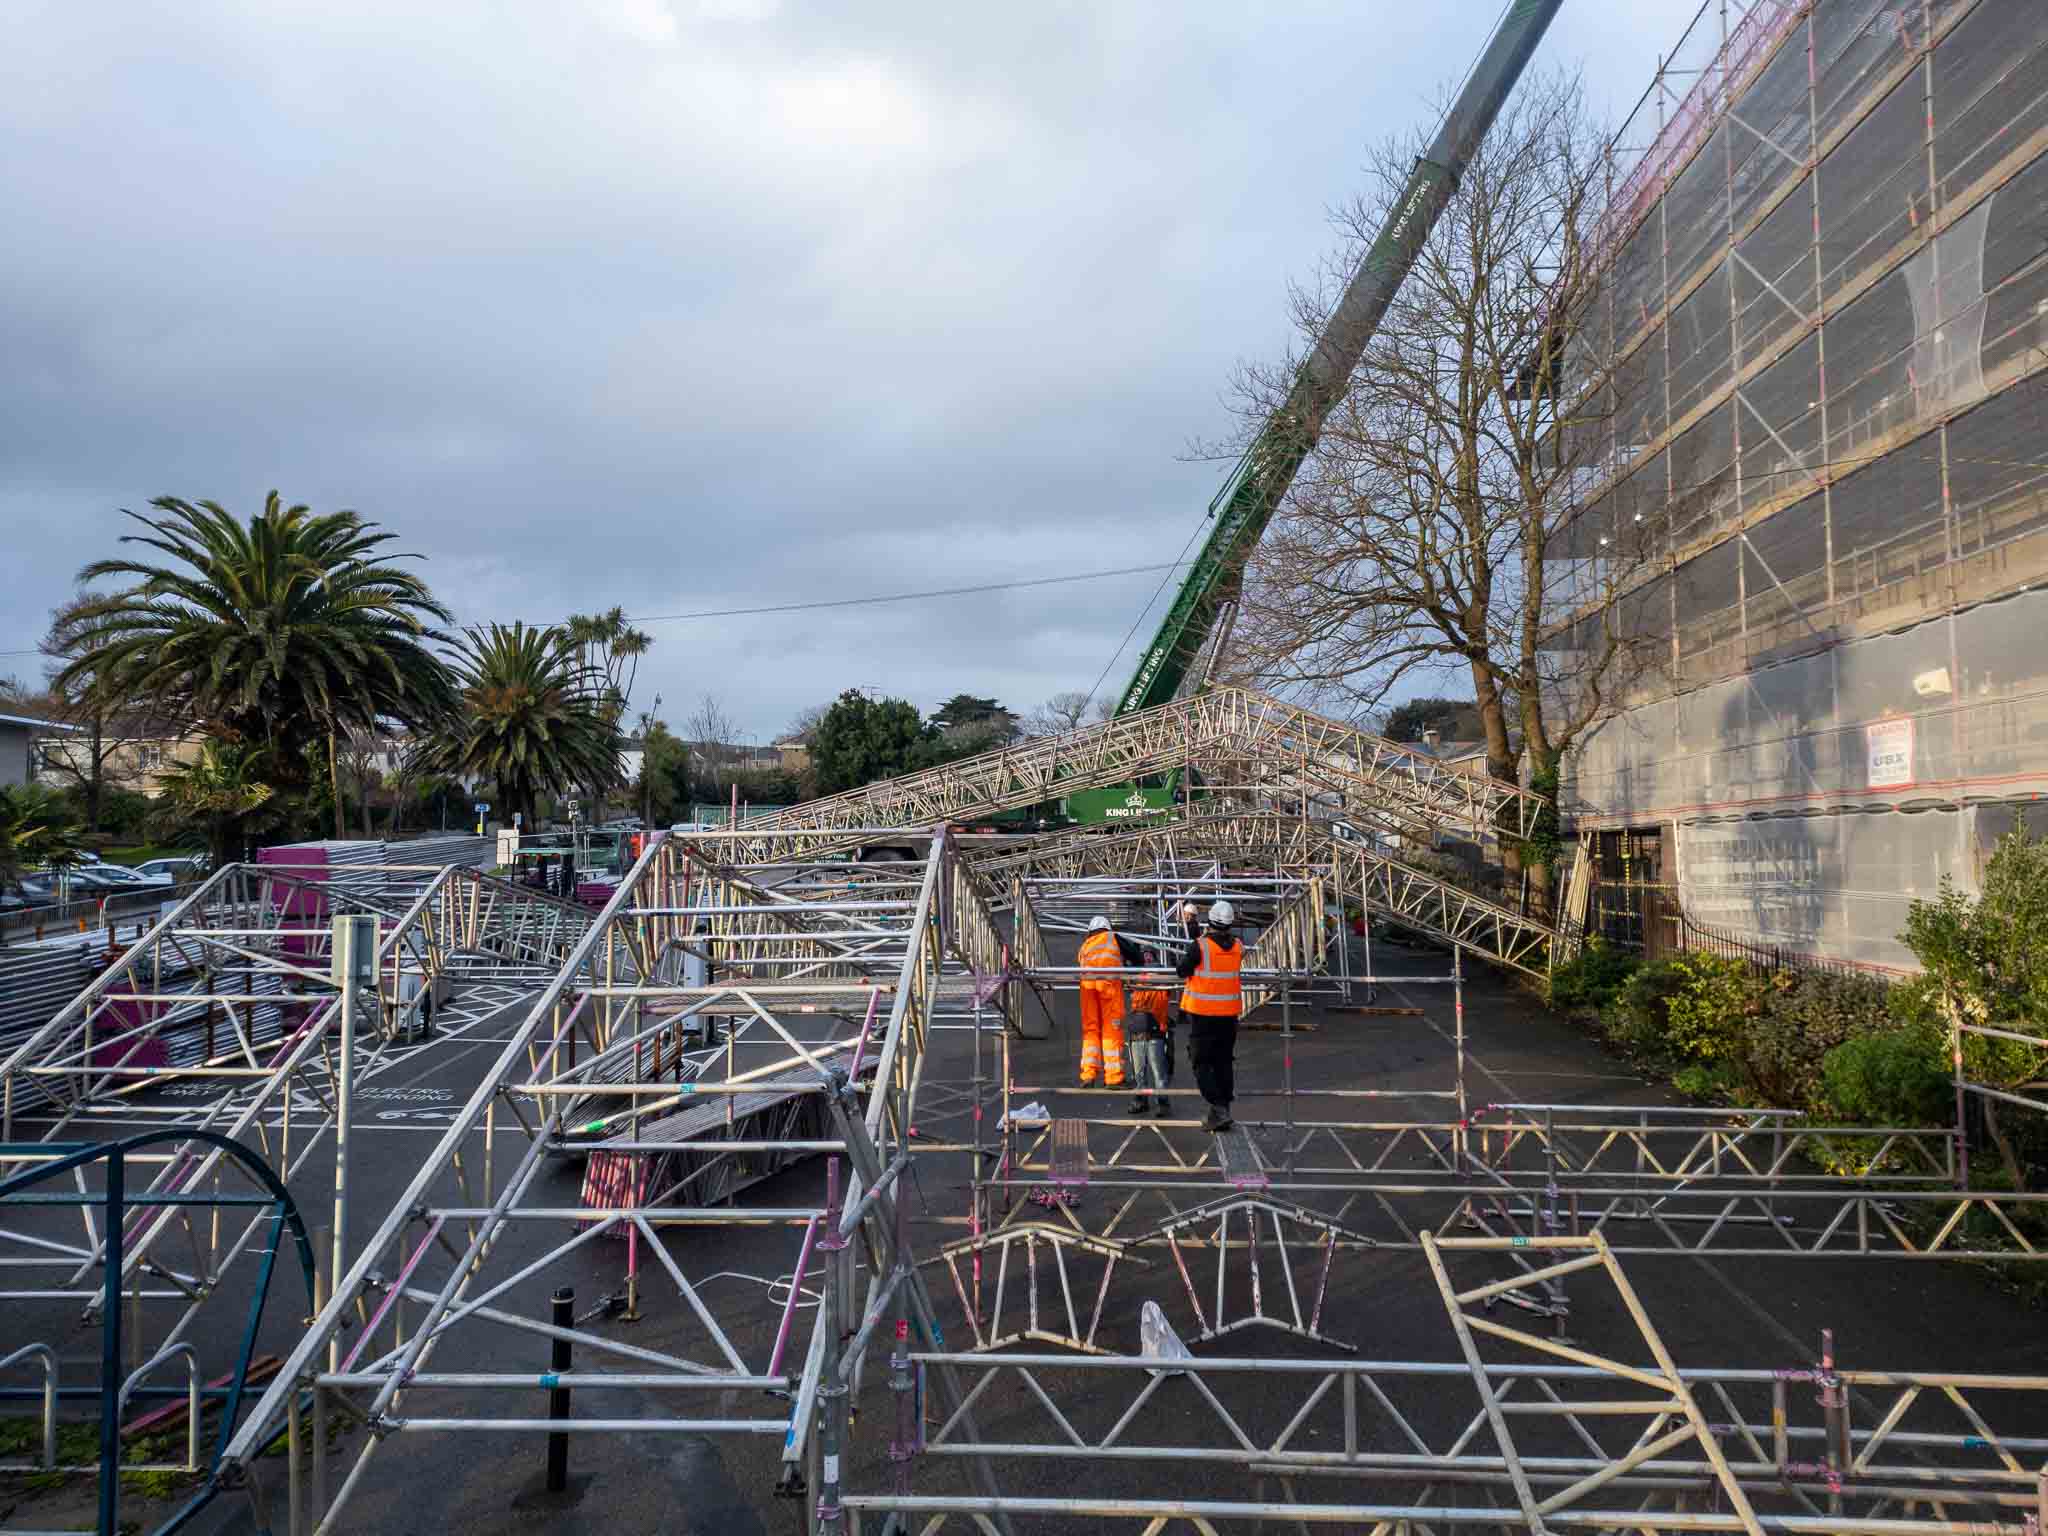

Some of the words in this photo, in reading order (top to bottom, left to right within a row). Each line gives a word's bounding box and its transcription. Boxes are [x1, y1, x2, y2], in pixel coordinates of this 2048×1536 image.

[1136, 647, 1164, 687] LIFTING
[1106, 809, 1129, 817] KING
[352, 1093, 455, 1101] CHARGING
